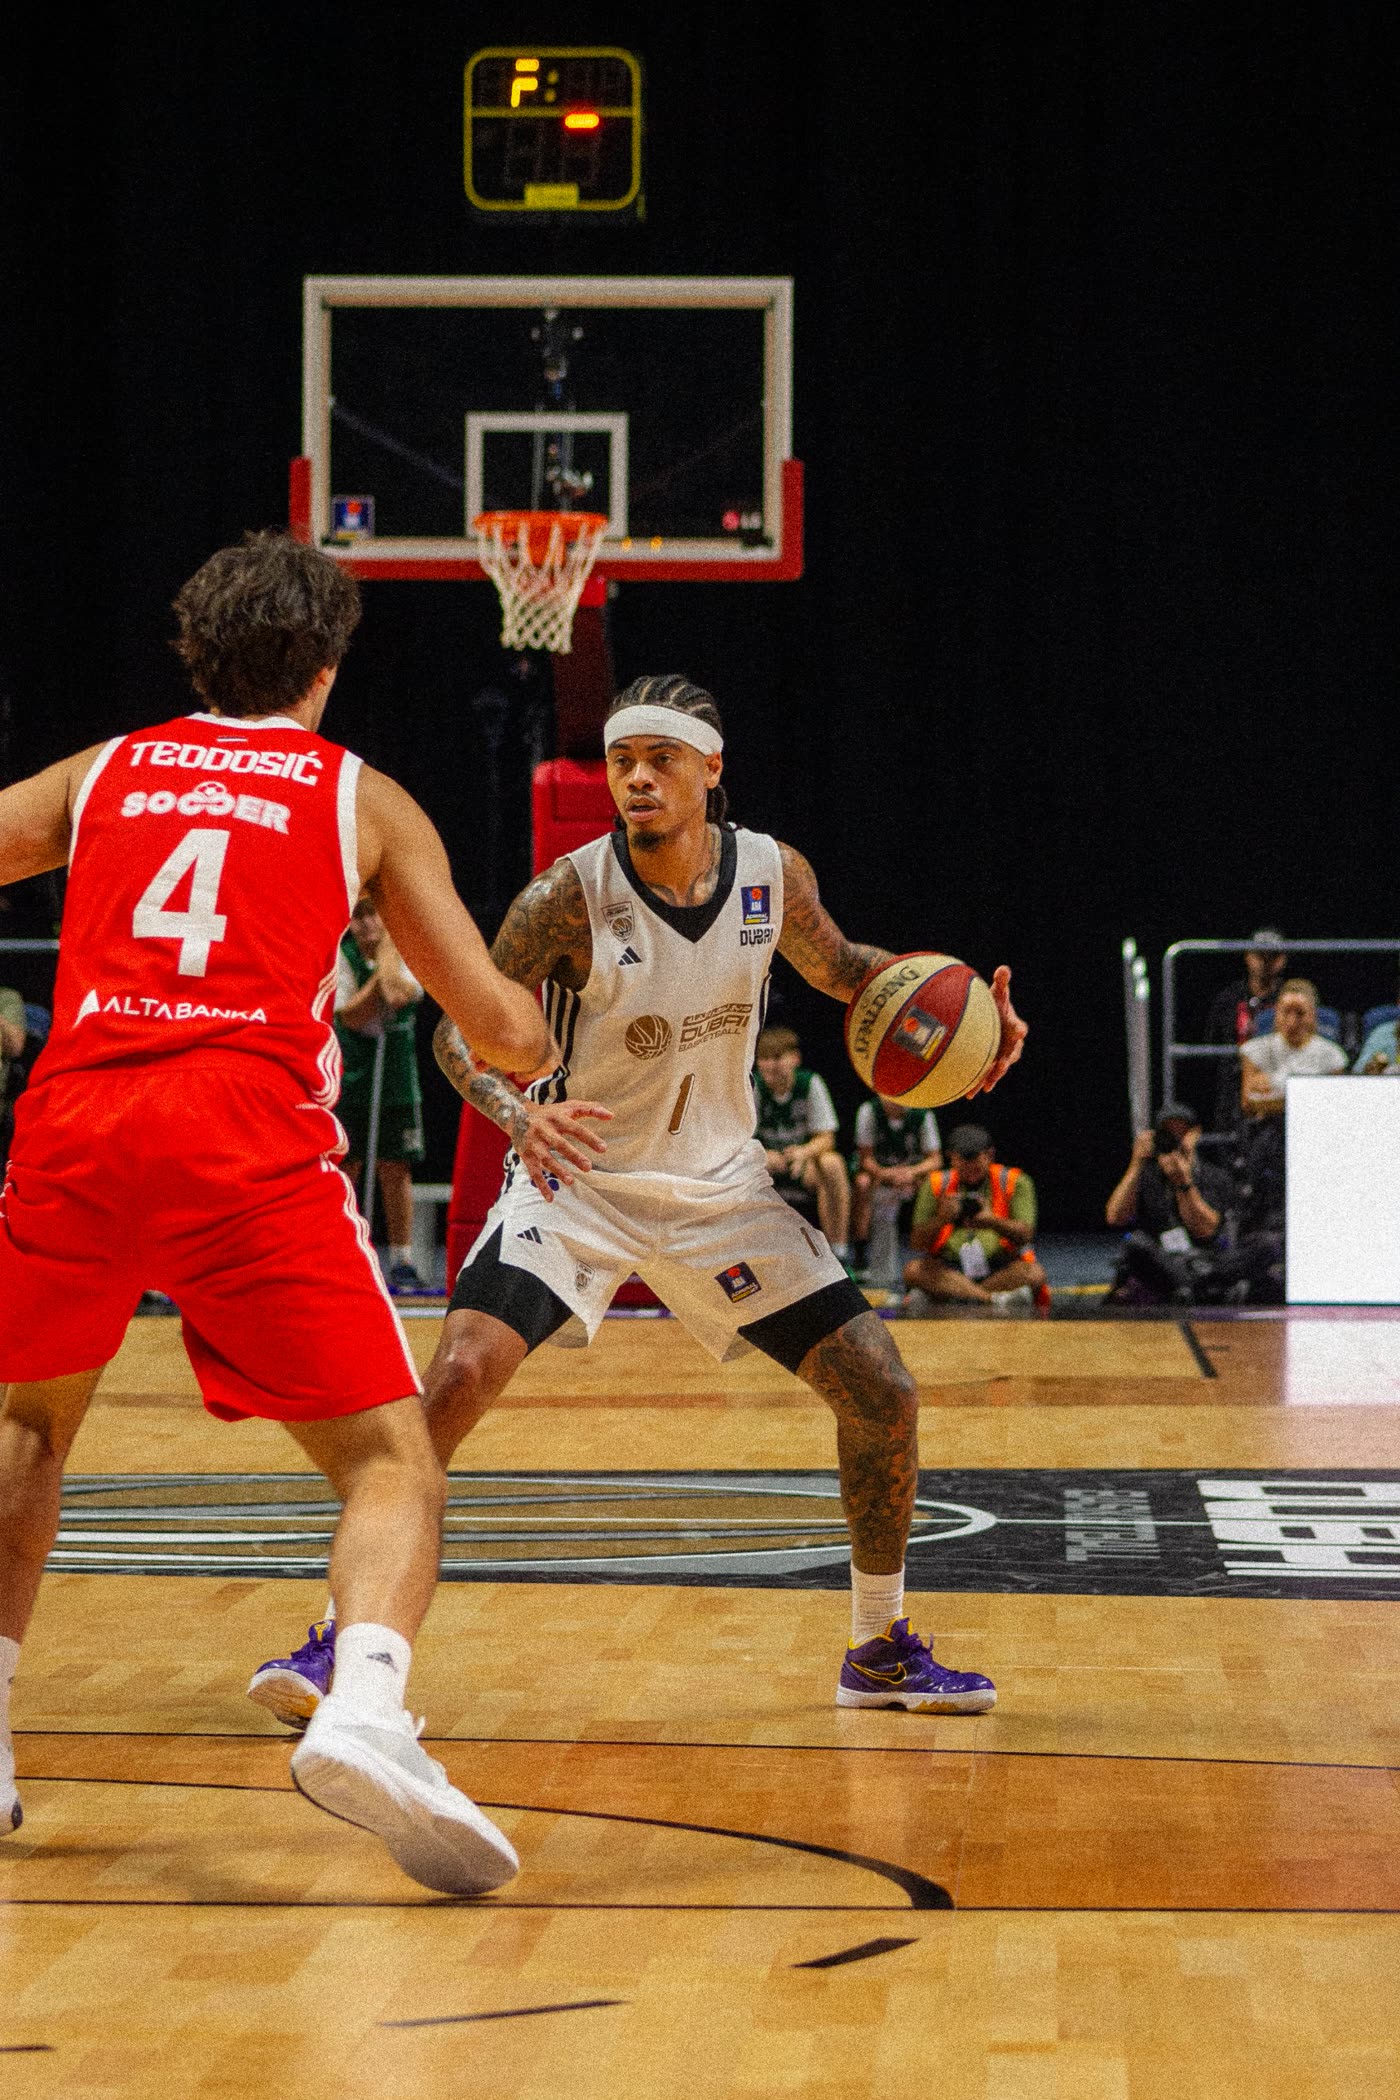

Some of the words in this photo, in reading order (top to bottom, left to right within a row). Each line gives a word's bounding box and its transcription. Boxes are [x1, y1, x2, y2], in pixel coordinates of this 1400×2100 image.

[131, 741, 324, 786] TEODOSIĆ
[120, 789, 292, 835] SOCCER
[132, 828, 231, 978] 4
[101, 996, 267, 1024] ALTABANKA
[680, 1015, 750, 1042] DUBAI
[854, 965, 921, 1059] SPALDING
[679, 1028, 741, 1052] BASKETBALL
[668, 1073, 696, 1135] 1
